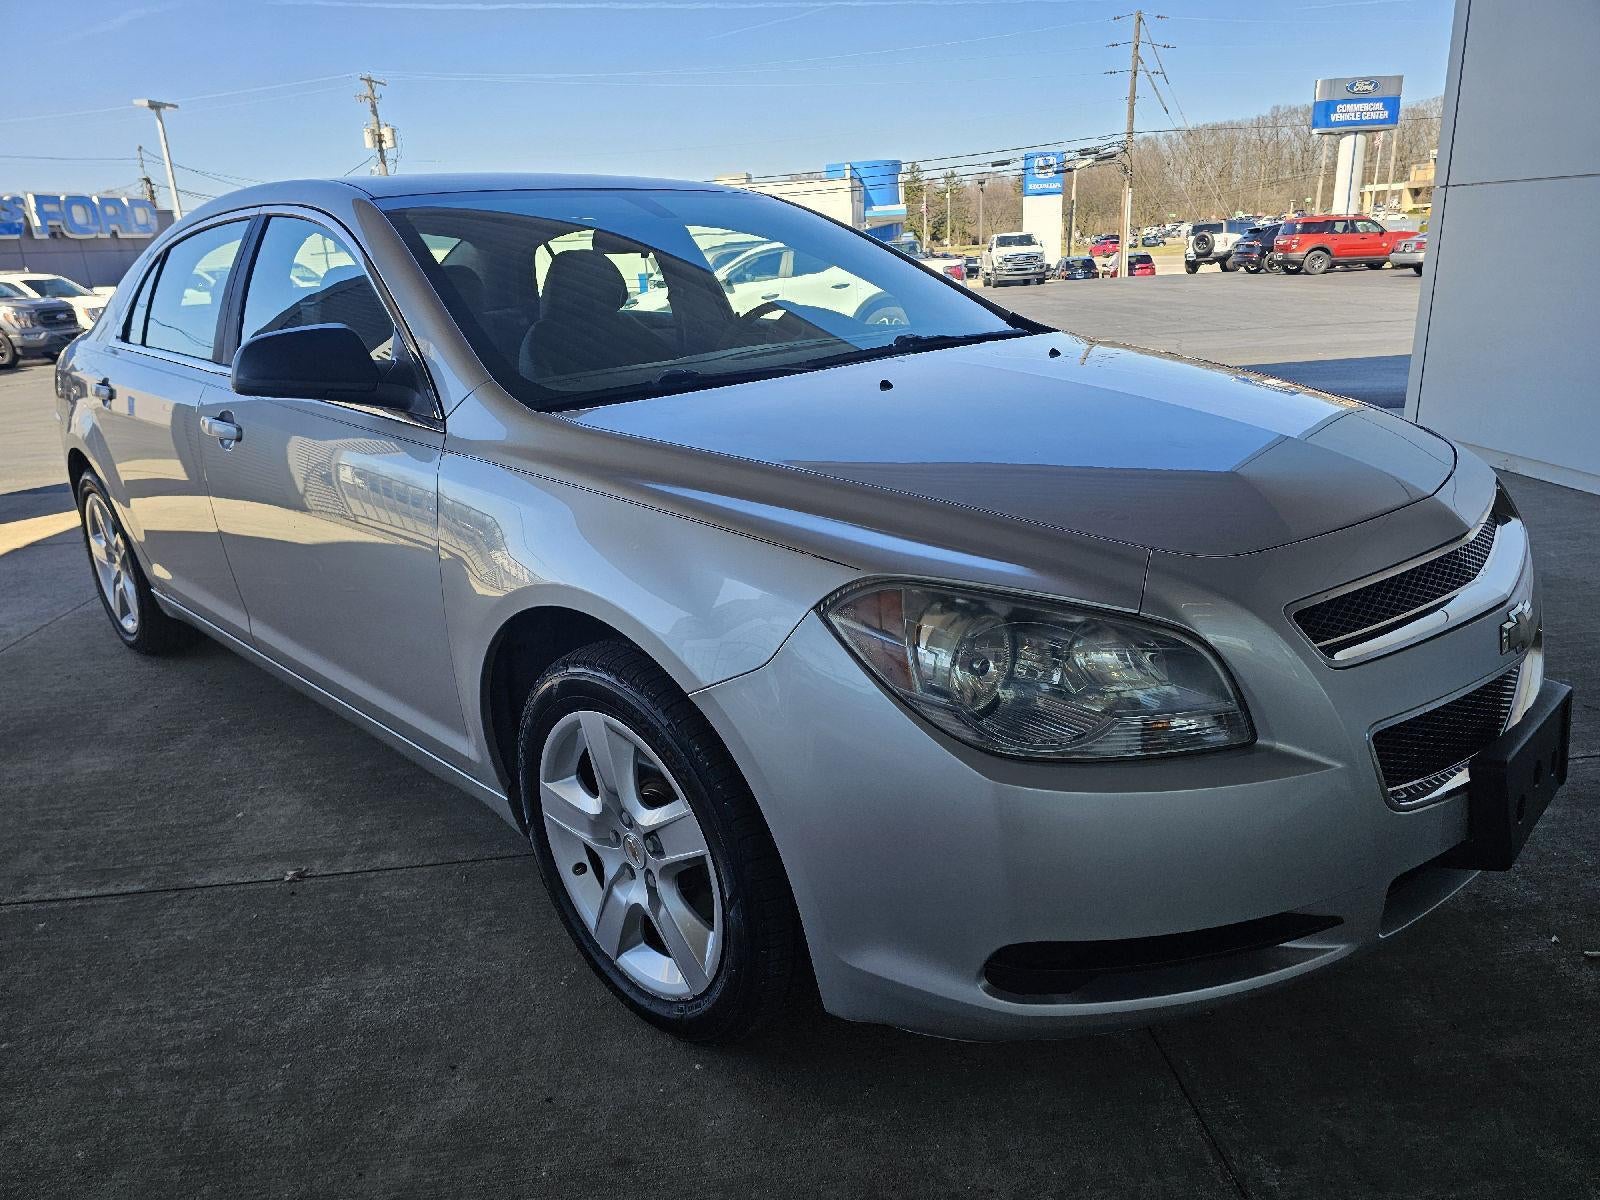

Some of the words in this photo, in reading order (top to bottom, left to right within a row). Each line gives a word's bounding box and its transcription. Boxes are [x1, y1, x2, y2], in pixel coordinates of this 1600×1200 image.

[1354, 80, 1374, 92] Ford
[1336, 102, 1385, 113] COMMERCIAL
[1330, 112, 1360, 122] VEHICLE
[1361, 111, 1388, 120] CENTER
[27, 193, 158, 239] FORD
